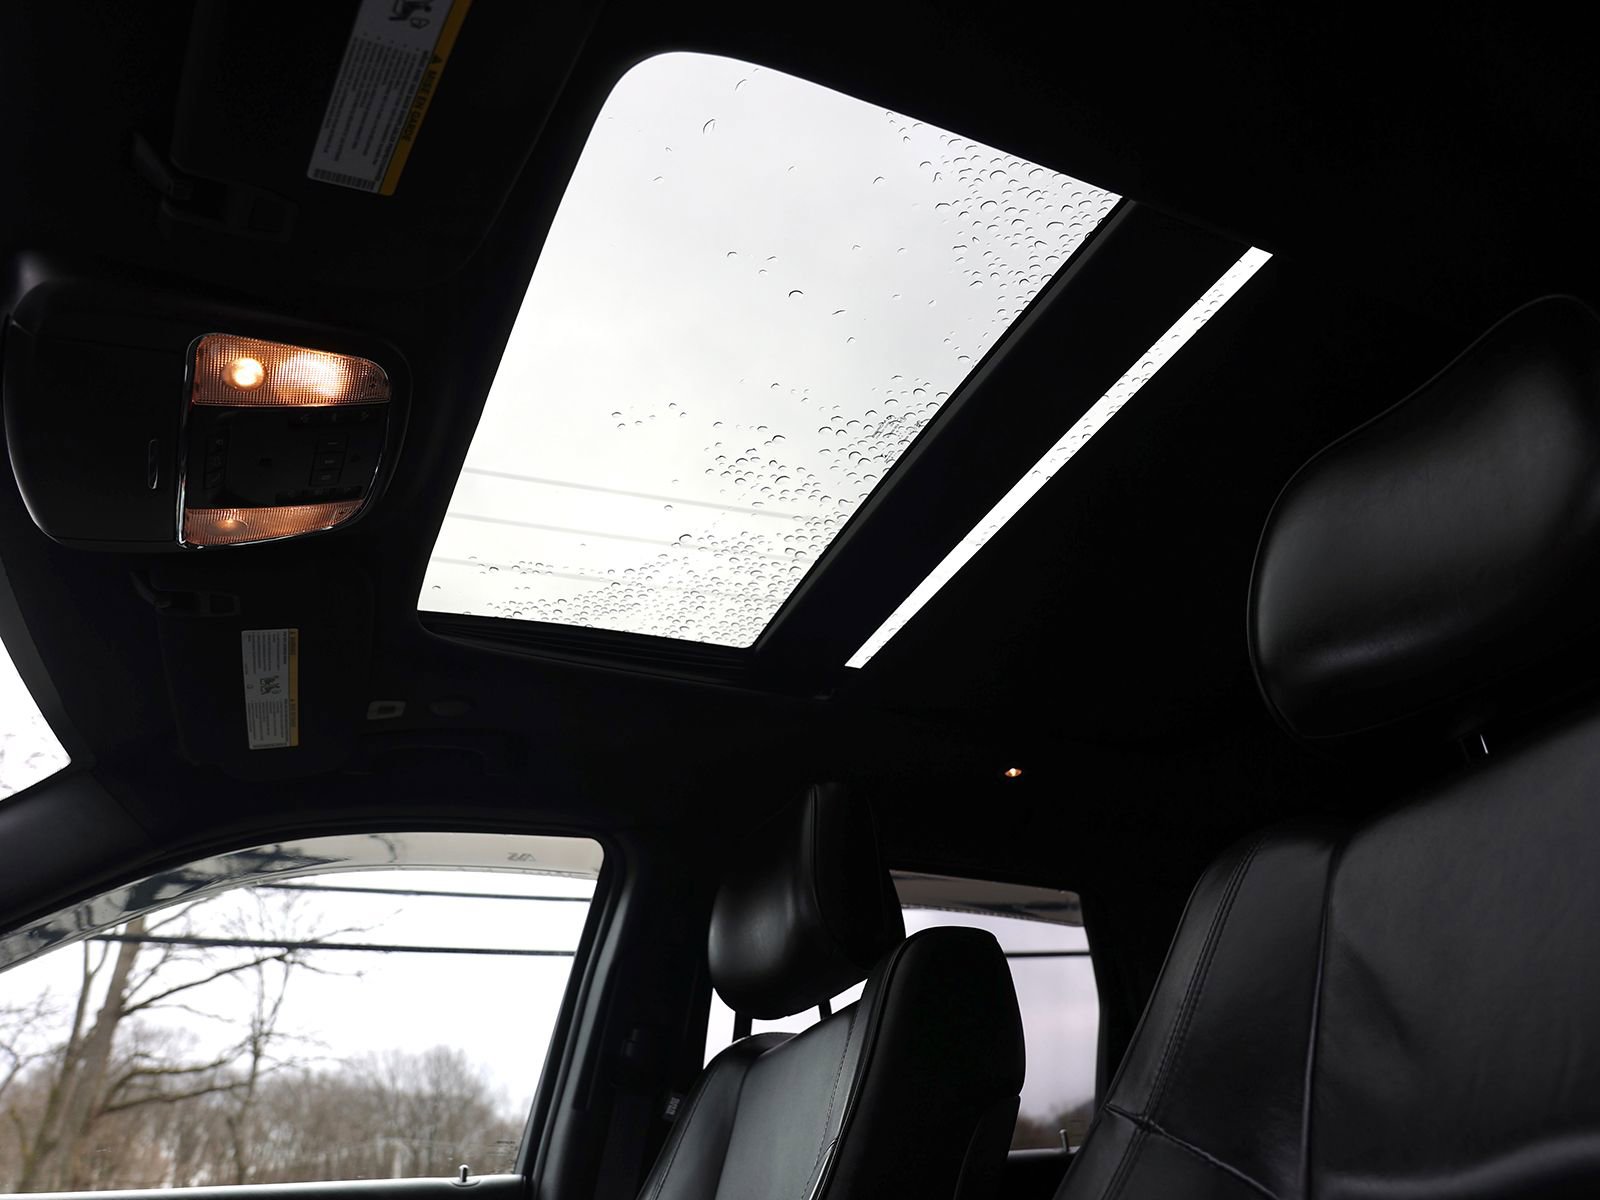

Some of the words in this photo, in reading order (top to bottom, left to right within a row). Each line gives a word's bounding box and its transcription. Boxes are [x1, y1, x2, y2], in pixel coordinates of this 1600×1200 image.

[420, 69, 437, 92] MISE
[413, 95, 426, 108] EN
[400, 110, 420, 141] GARDE
